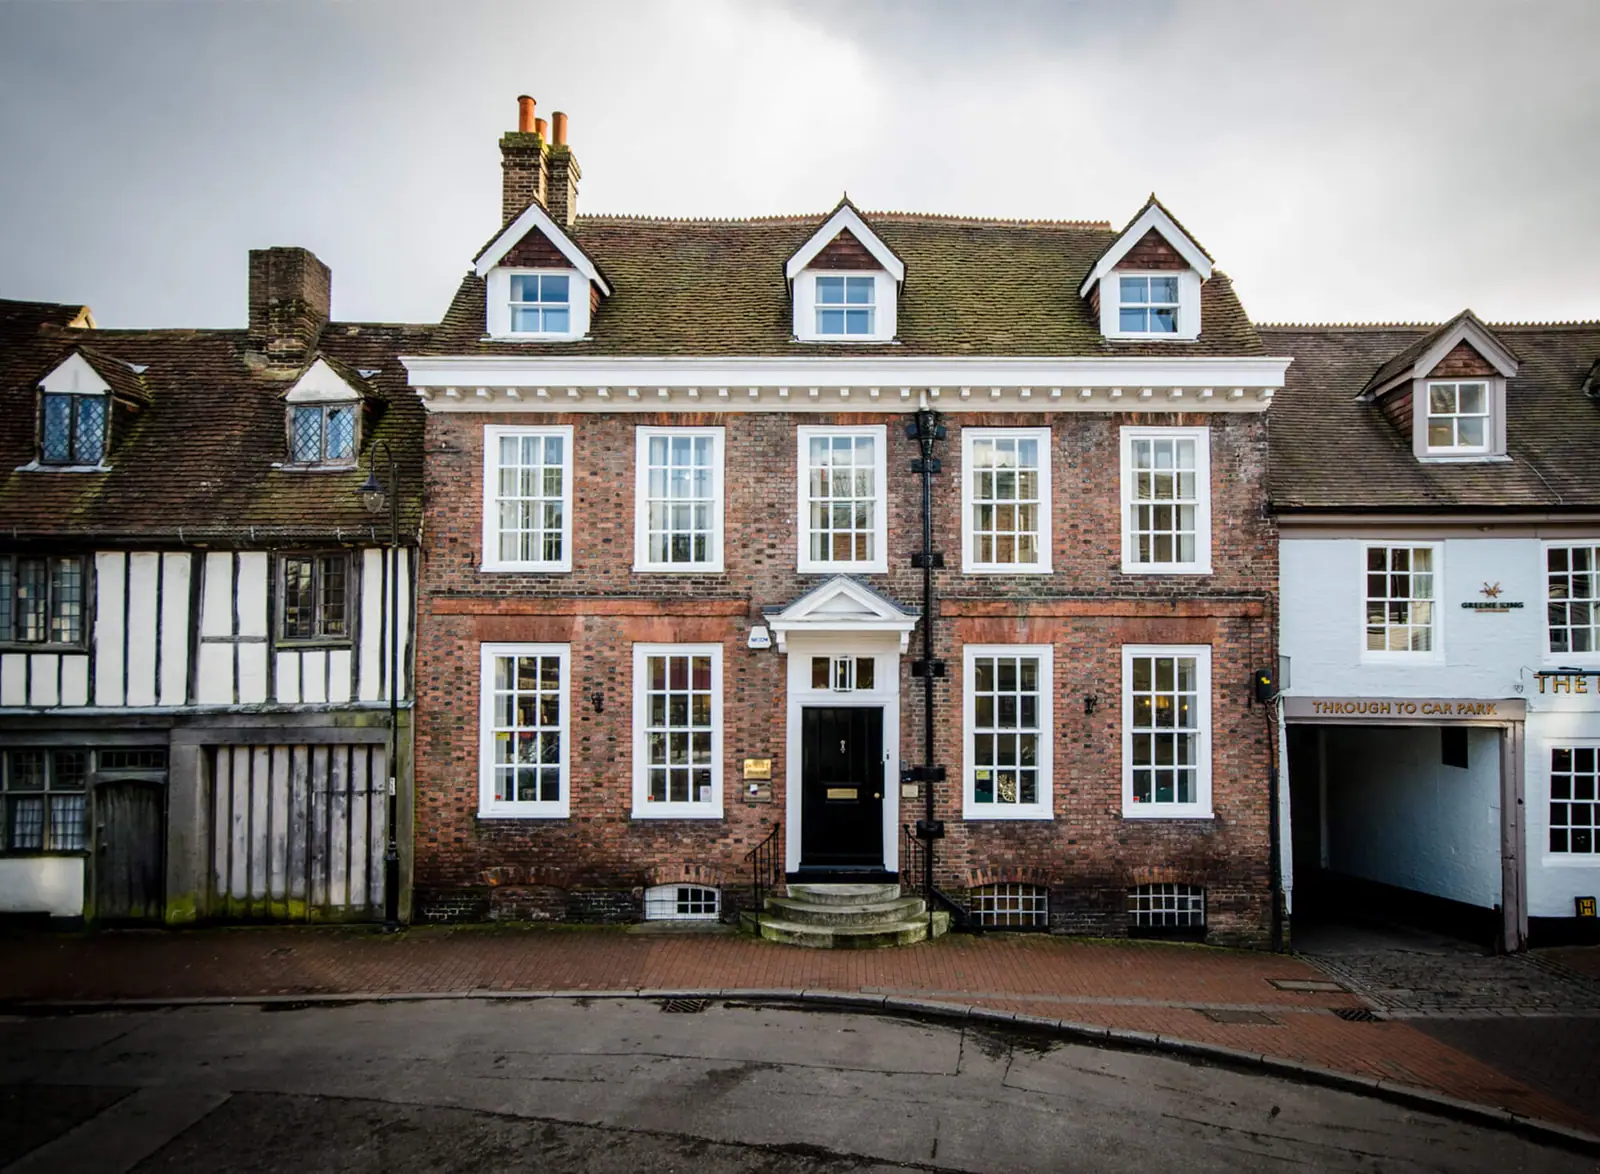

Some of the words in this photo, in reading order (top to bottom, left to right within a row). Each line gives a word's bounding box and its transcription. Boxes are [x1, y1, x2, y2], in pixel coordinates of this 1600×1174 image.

[1533, 673, 1588, 694] THE
[1312, 701, 1391, 714] THROUGH
[1395, 702, 1417, 715] TO
[1421, 702, 1453, 715] CAR
[1456, 702, 1497, 715] PARK
[1582, 900, 1594, 915] H
